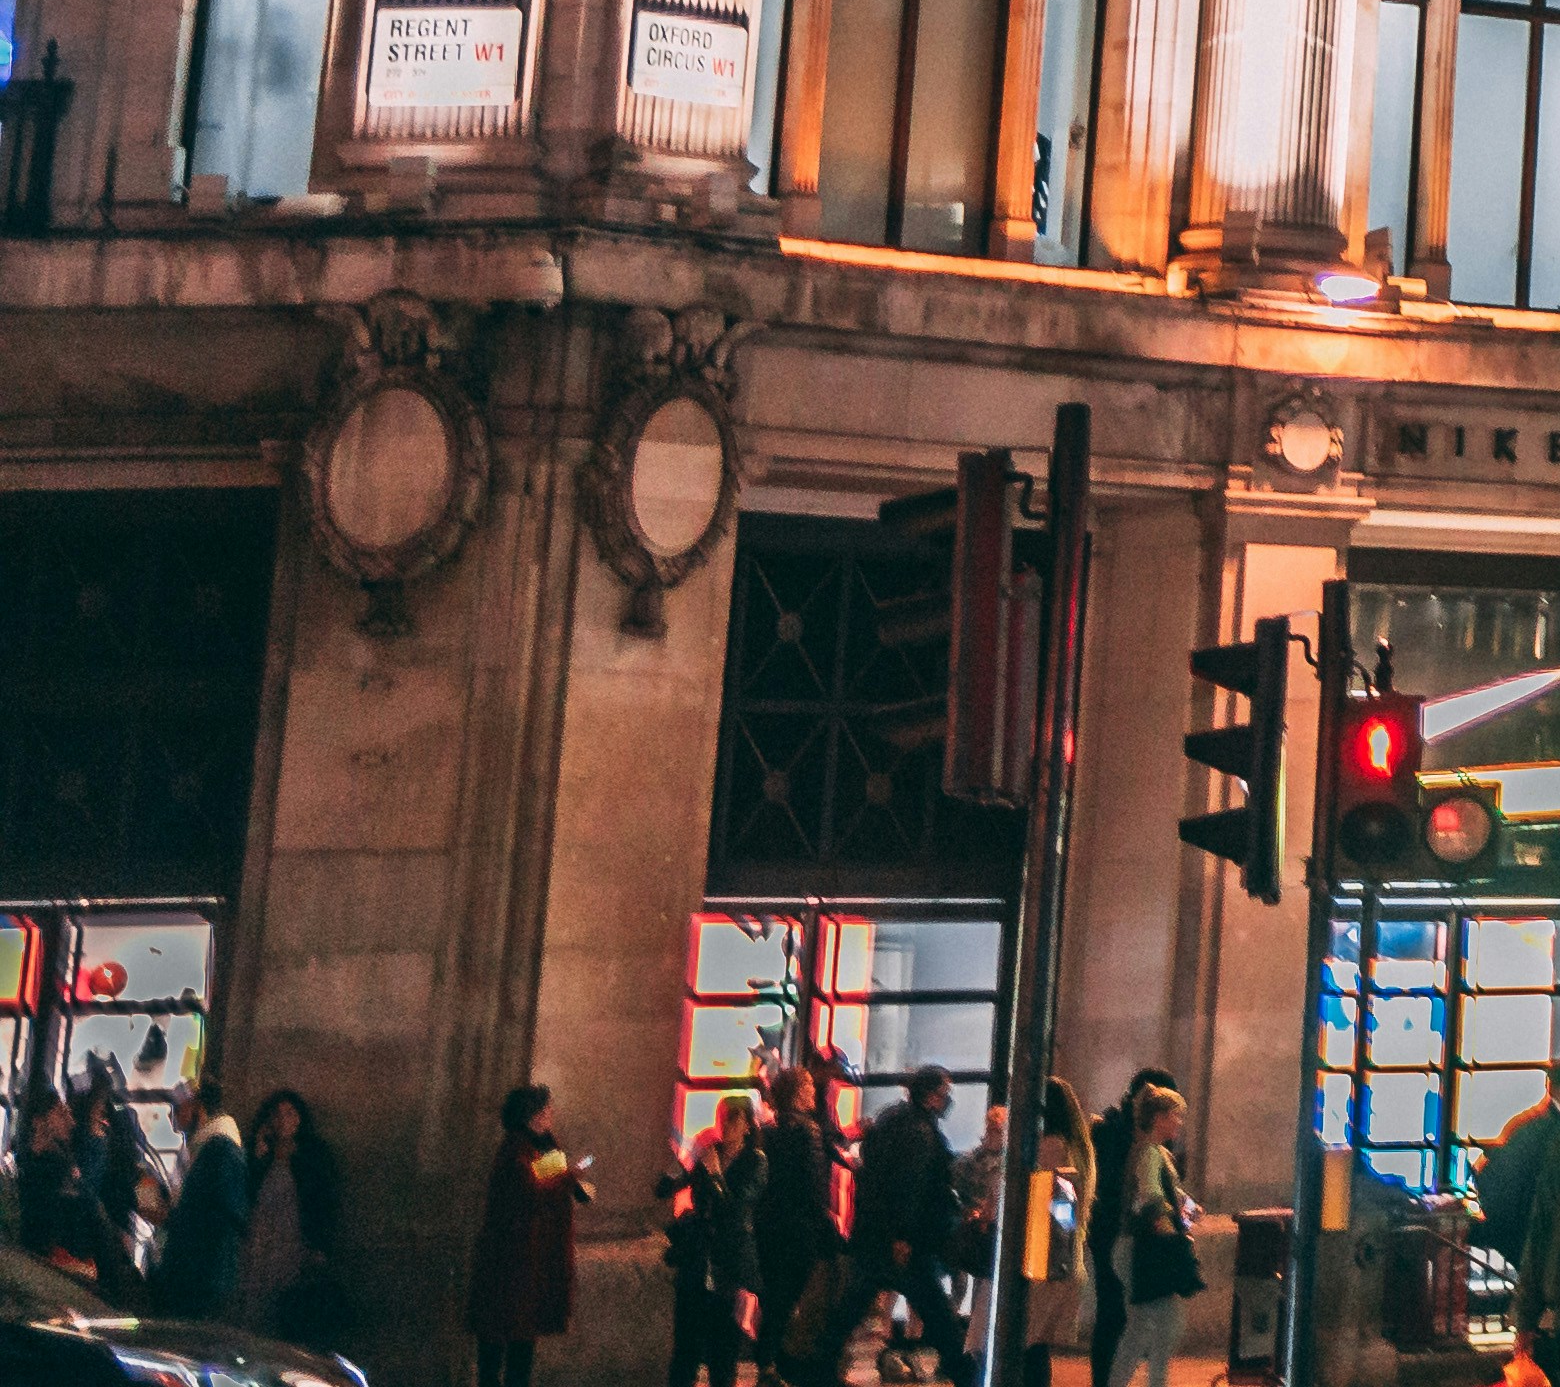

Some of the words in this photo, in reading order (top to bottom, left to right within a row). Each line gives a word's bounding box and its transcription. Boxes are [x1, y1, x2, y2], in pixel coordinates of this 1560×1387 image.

[390, 18, 472, 38] REGENT
[649, 22, 713, 50] OXFORD
[388, 43, 466, 63] STREET
[474, 42, 504, 62] W1
[647, 46, 706, 73] CIRCUS
[712, 57, 736, 79] W1
